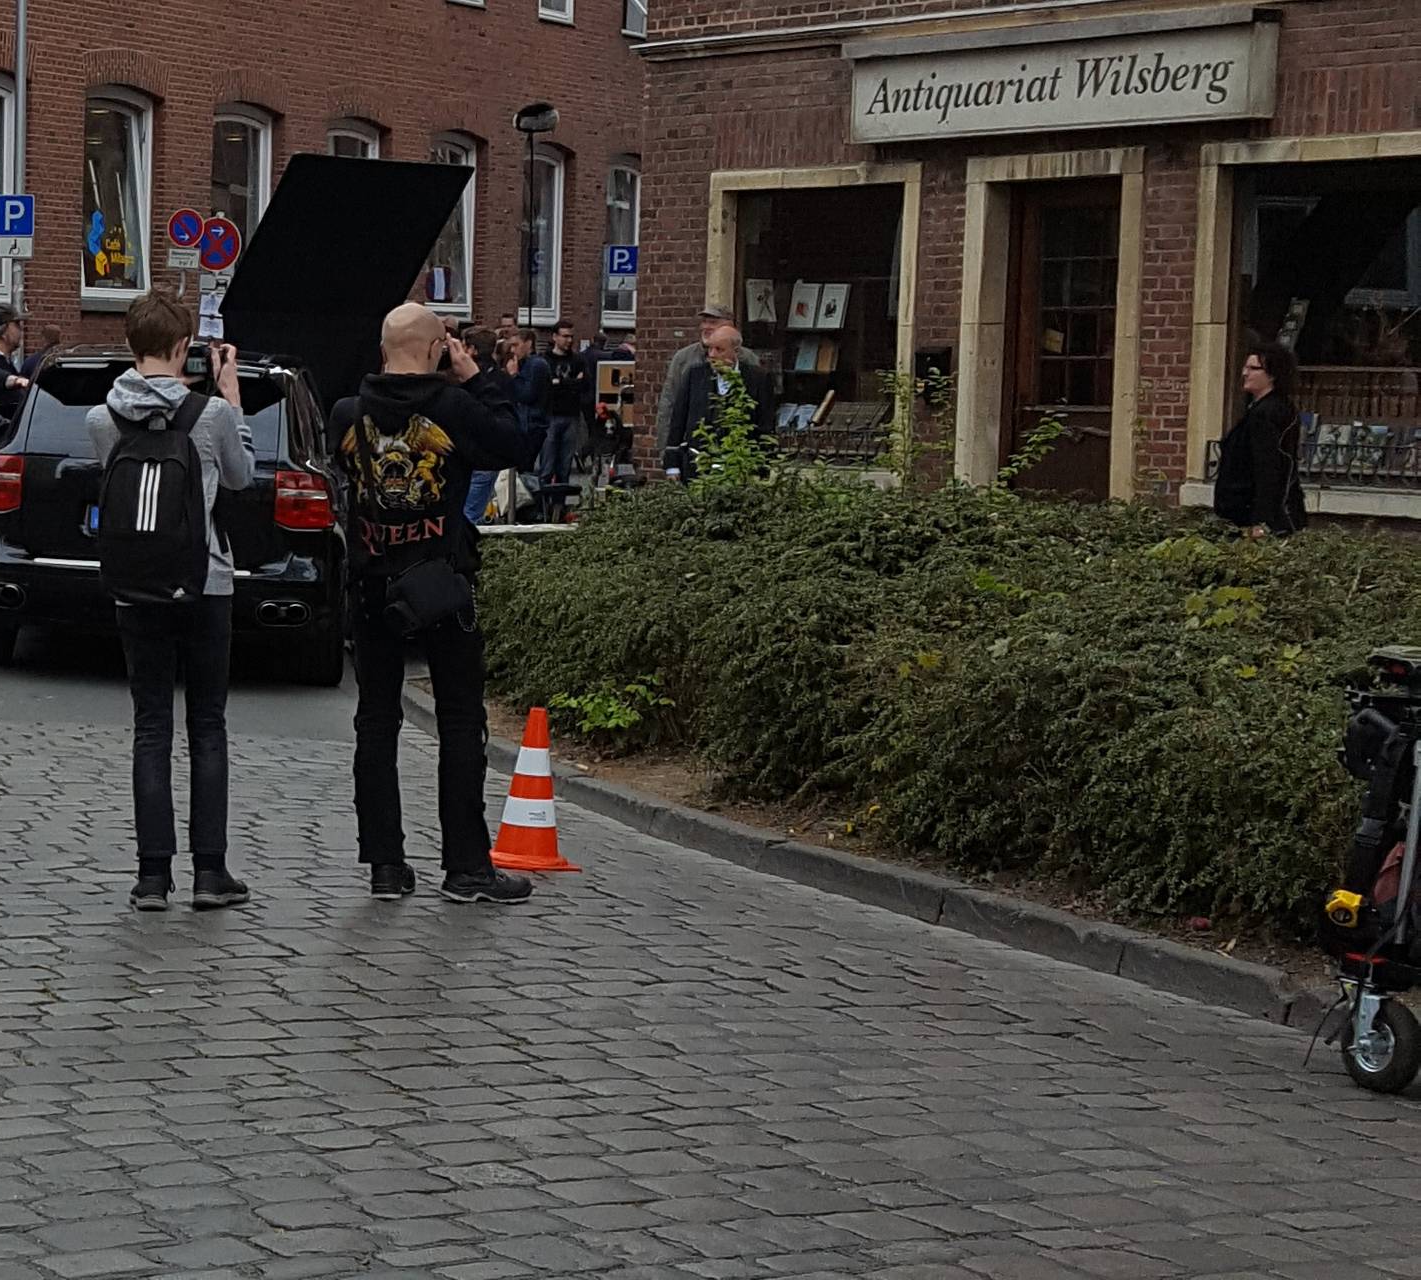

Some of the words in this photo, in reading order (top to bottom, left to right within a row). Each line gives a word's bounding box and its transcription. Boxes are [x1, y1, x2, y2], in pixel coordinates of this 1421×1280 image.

[865, 65, 1062, 124] Antiquariat
[1076, 53, 1234, 105] Wilsberg
[5, 200, 24, 231] P
[613, 249, 630, 271] P
[358, 516, 446, 555] QUEEN
